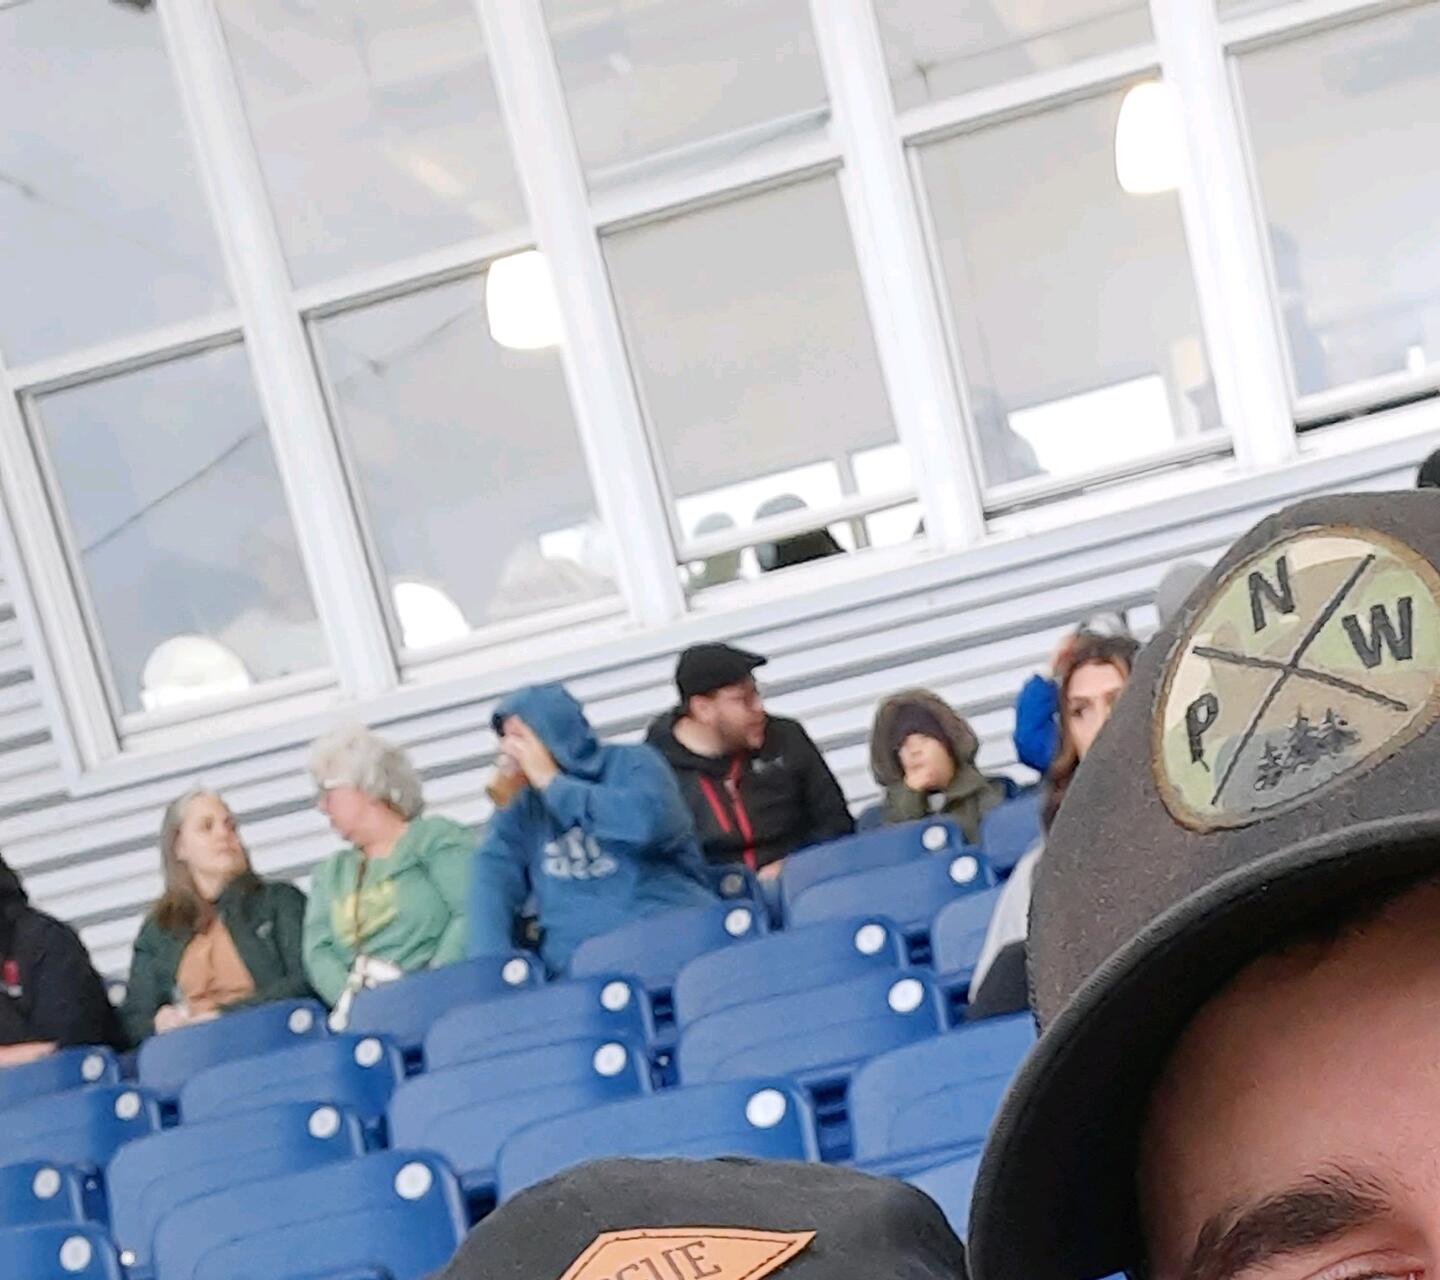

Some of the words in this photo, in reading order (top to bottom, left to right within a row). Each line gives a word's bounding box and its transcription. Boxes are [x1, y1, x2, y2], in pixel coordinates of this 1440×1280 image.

[1249, 555, 1295, 633] N
[1341, 596, 1413, 669] W
[1185, 692, 1219, 766] P
